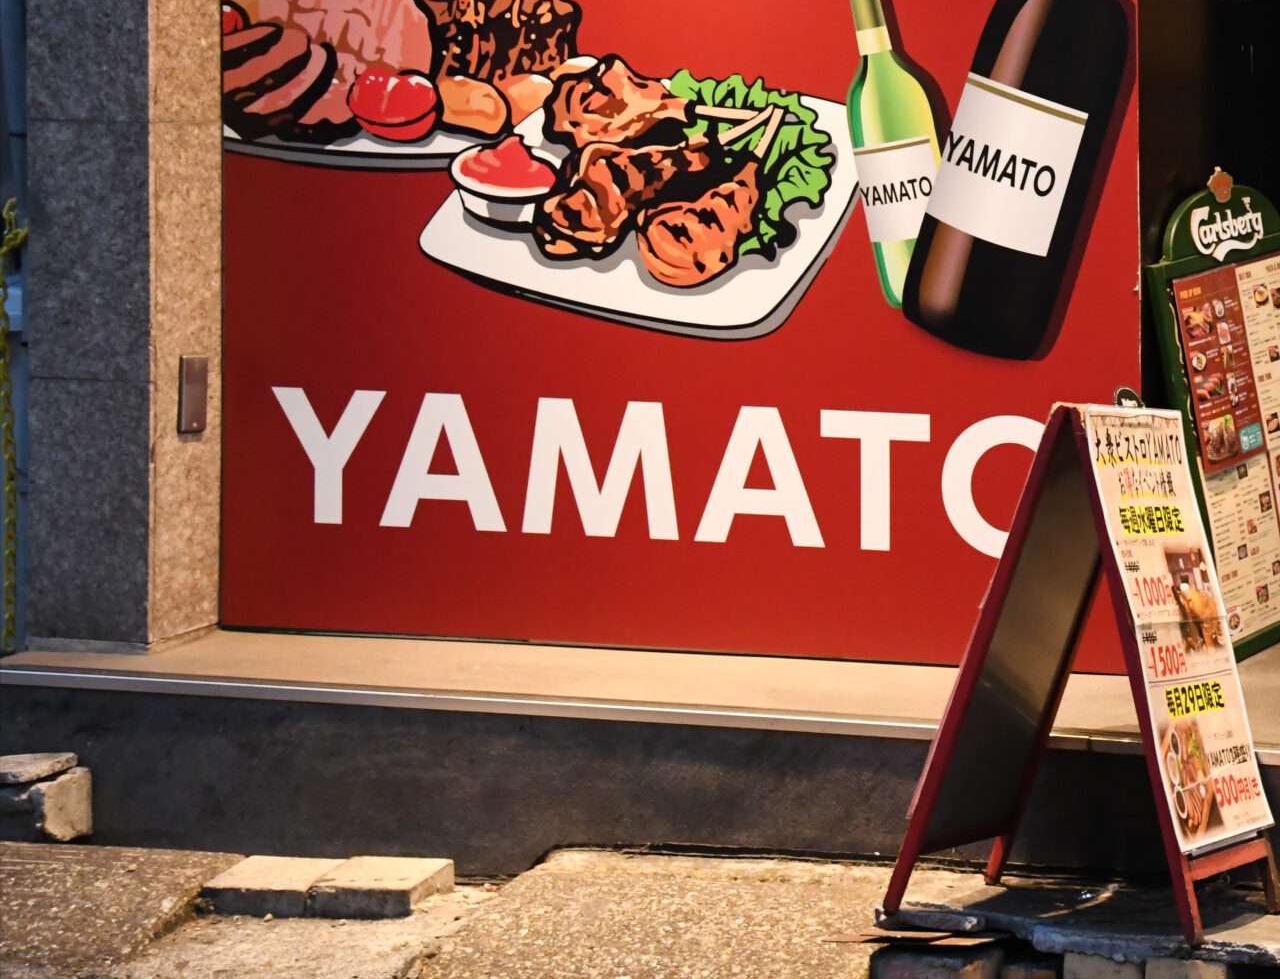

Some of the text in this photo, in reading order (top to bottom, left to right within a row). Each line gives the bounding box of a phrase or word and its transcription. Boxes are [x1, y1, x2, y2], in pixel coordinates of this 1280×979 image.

[947, 131, 1056, 197] YAMATO
[860, 176, 933, 207] YAMATO
[1190, 200, 1264, 256] Carlsberg
[1118, 506, 1185, 534] 毎週水曜日限定
[1165, 682, 1225, 717] 毎月29日限定
[1213, 774, 1261, 809] 500円引き
